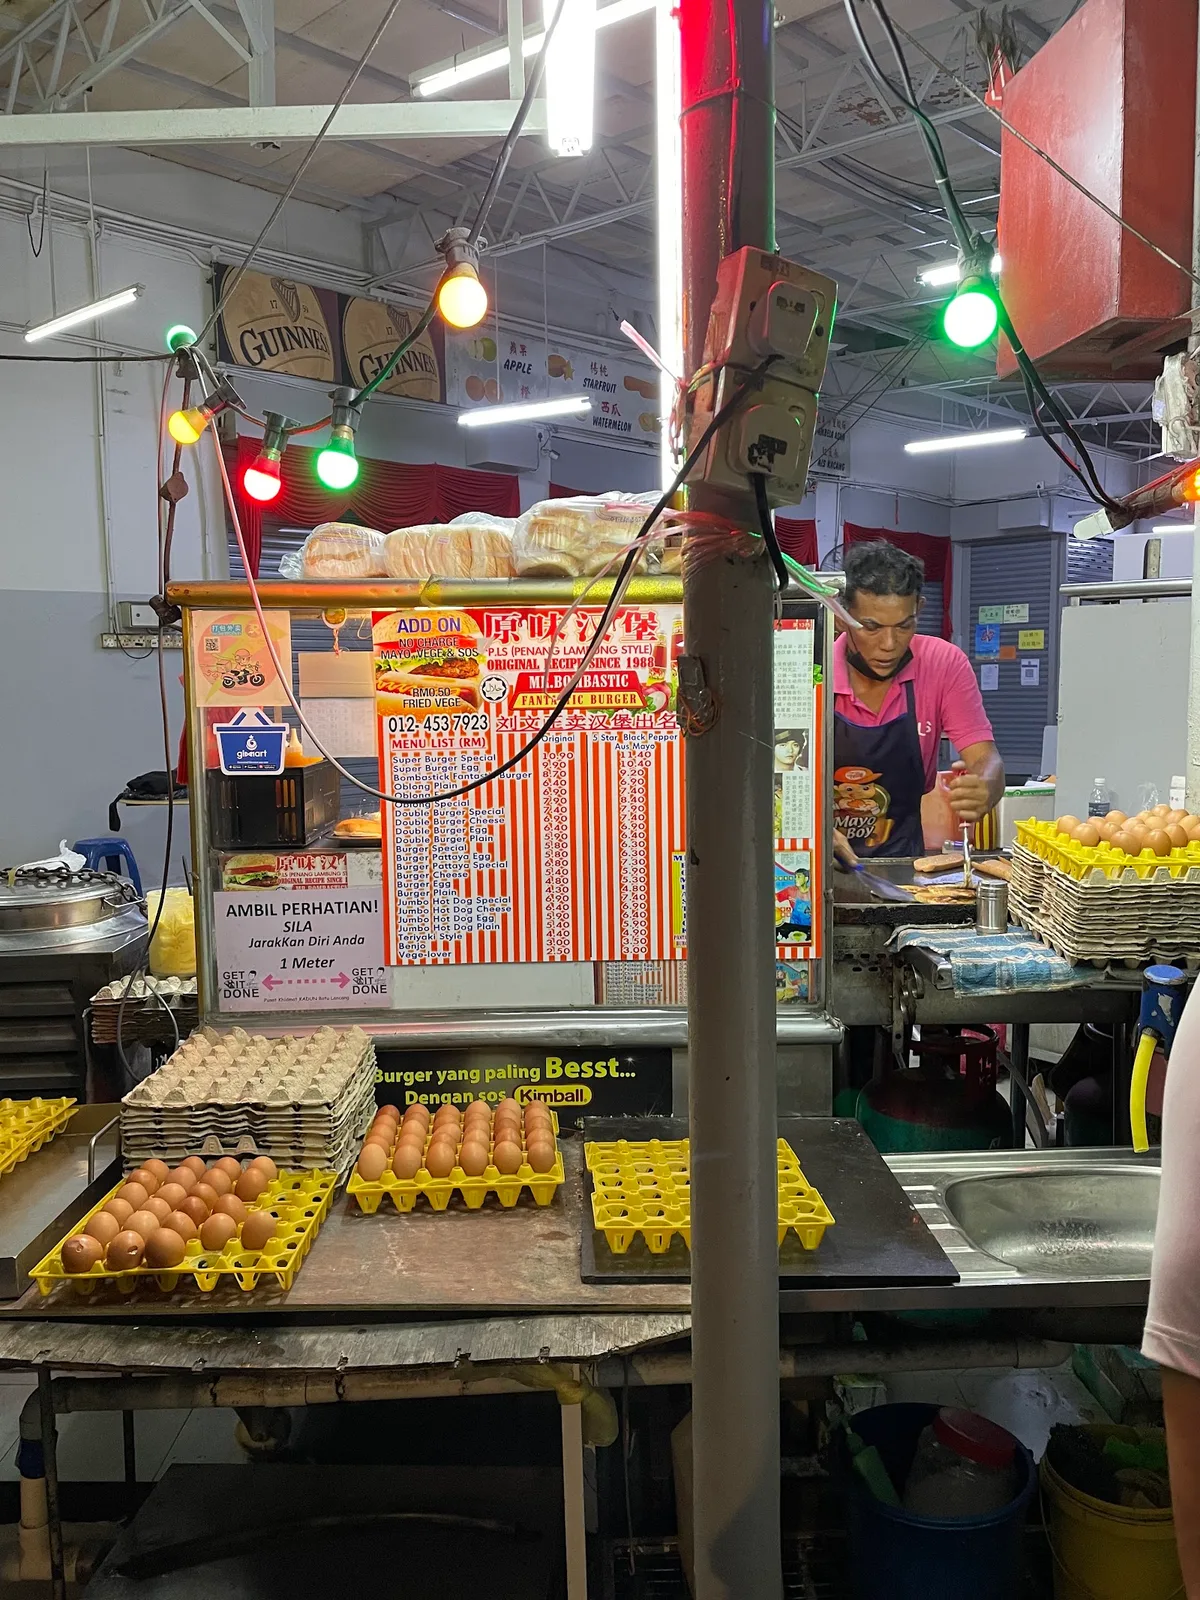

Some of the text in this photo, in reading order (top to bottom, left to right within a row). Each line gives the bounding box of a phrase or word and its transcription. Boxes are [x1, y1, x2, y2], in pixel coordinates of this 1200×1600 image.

[239, 326, 330, 366] GUINNESS
[504, 359, 532, 374] APPLE
[582, 378, 617, 394] STARFRUIT
[601, 402, 622, 417] 西瓜
[592, 416, 632, 432] WATERMELON
[397, 617, 461, 634] ADD ON
[484, 611, 658, 644] 原味汉堡
[399, 637, 458, 648] NO CHARGE
[446, 648, 455, 658] &
[458, 648, 479, 658] SOS
[511, 645, 560, 656] (PENANG
[563, 646, 618, 656] LAMUNG
[622, 644, 652, 654] STYLE)
[487, 659, 540, 670] ORIGINAL
[589, 658, 620, 669] SINCE
[626, 656, 654, 668] 1988
[412, 688, 450, 698] RM0.50
[590, 693, 637, 704] BURGER
[403, 698, 460, 708] FRIED VEGE
[388, 715, 488, 732] 012- 453 7923
[392, 737, 486, 748] MENU LIST (RM)
[542, 734, 575, 742] Original
[592, 734, 598, 742] 5
[623, 733, 646, 741] Black
[648, 733, 678, 743] Pepper
[632, 742, 656, 752] Mayo
[834, 815, 876, 830] Mayo
[846, 826, 875, 840] Boy
[226, 900, 378, 917] AMBIL PERHATIAN!
[283, 921, 312, 932] SILA
[249, 934, 365, 948] JarakKan Diri Anda
[280, 957, 335, 969] 1 Meter
[223, 971, 245, 979] GET
[224, 989, 259, 998] DONE
[353, 985, 387, 994] DONE
[374, 1057, 636, 1086] Burger yang paling Besst...
[405, 1089, 584, 1104] Dengan sos Kimball
